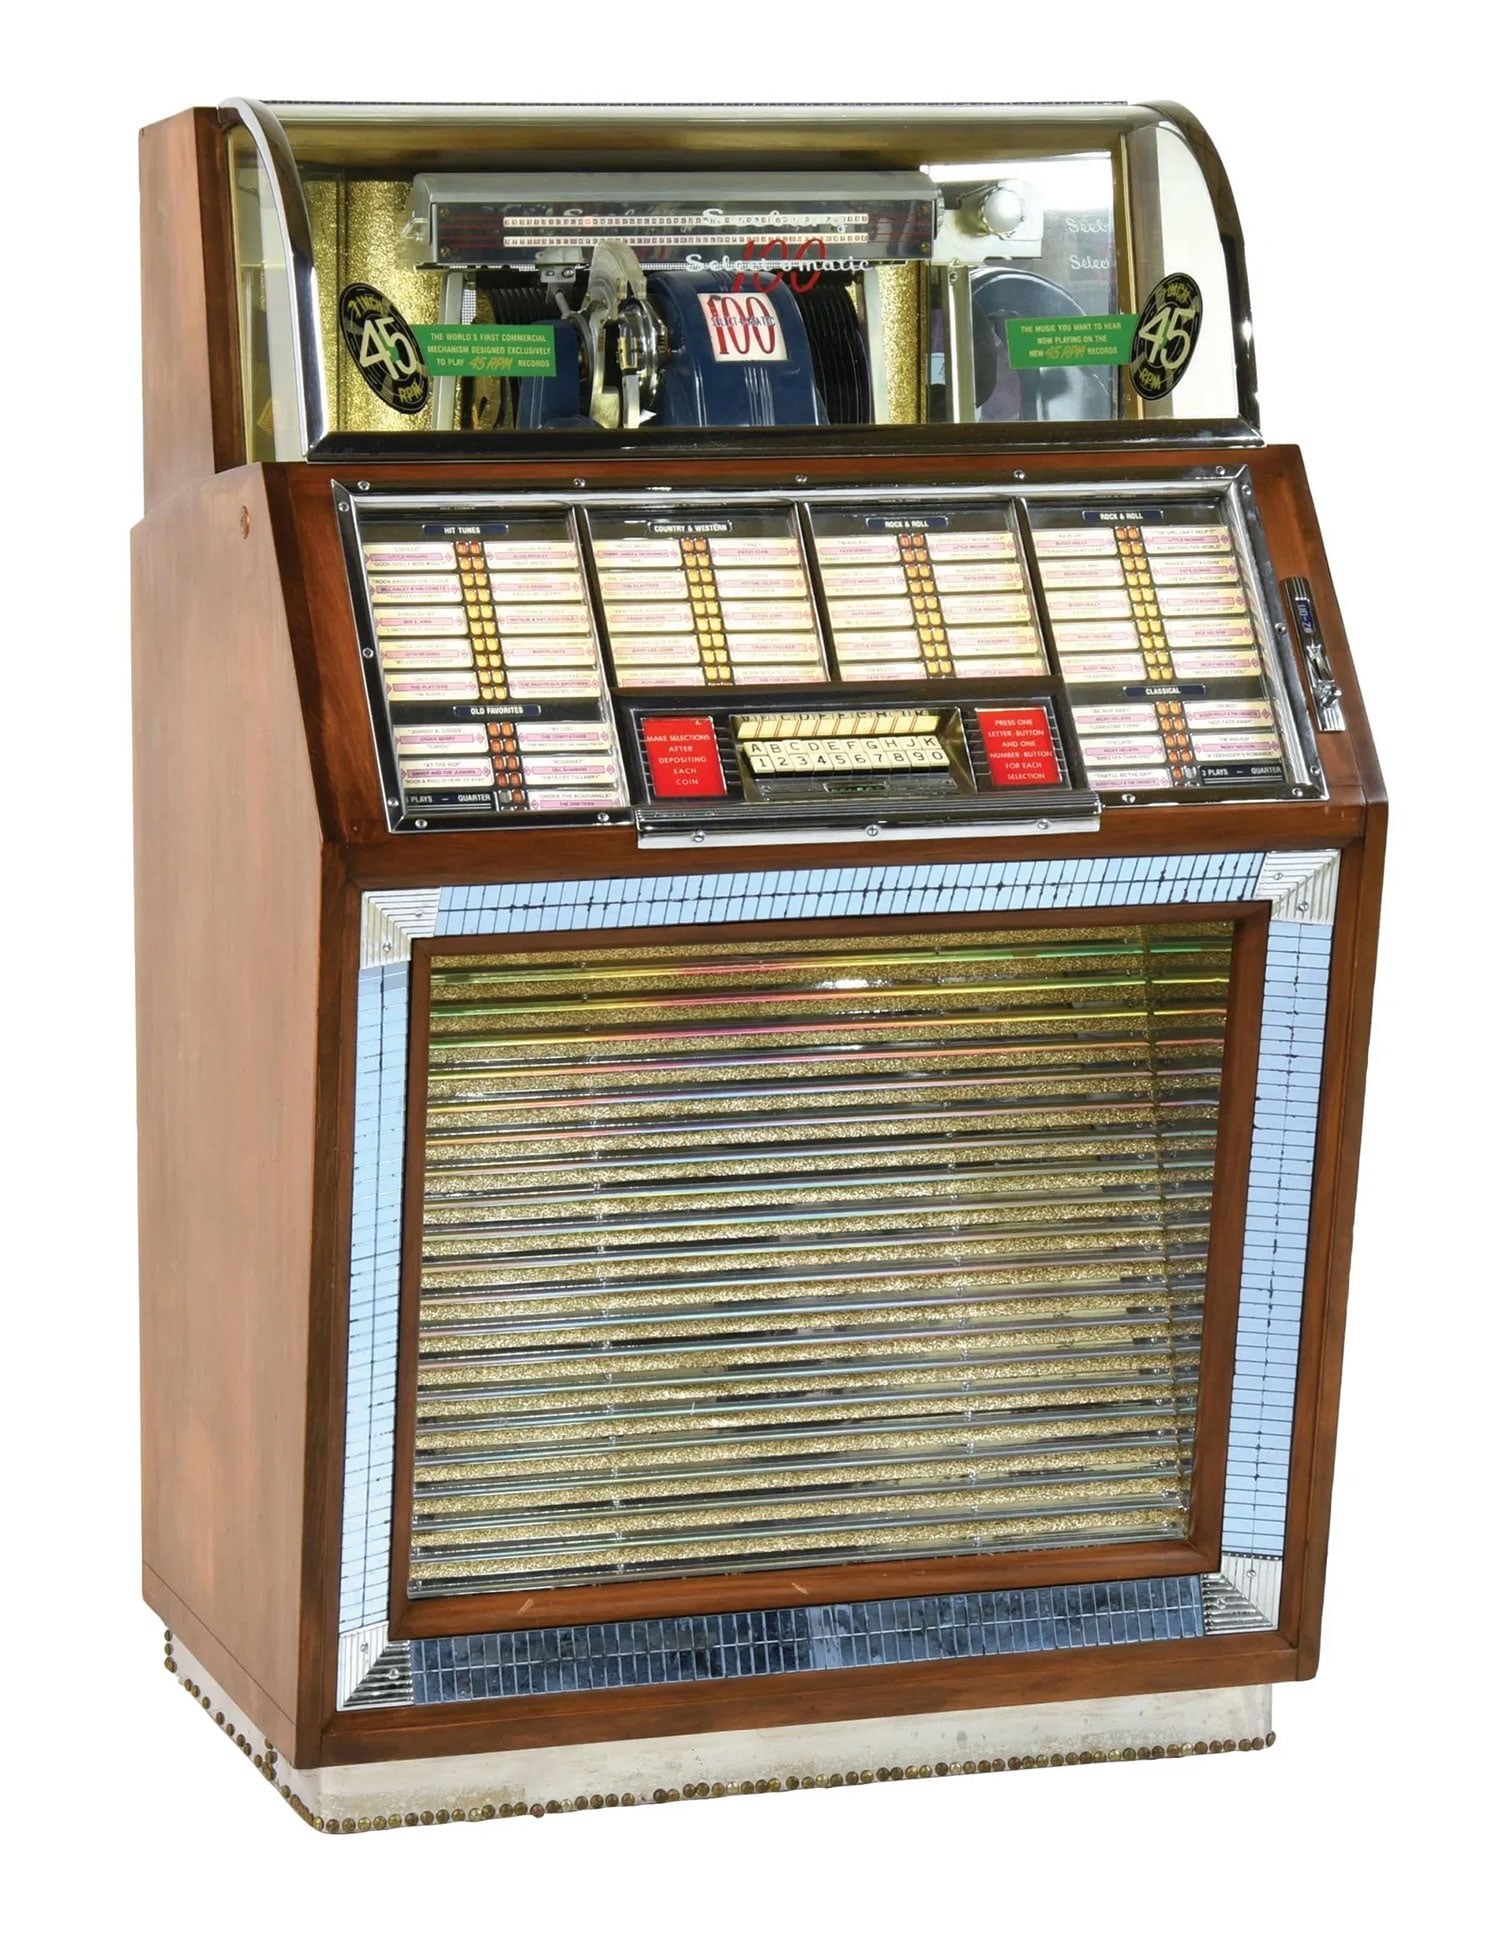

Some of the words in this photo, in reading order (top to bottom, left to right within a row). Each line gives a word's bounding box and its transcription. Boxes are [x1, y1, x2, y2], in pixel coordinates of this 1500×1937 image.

[732, 238, 826, 293] 100
[707, 295, 775, 354] 100
[1139, 306, 1196, 369] 45
[360, 317, 417, 380] 45
[472, 346, 505, 354] DESIGNED
[1088, 347, 1117, 355] RECORDS
[470, 356, 486, 370] 45
[487, 357, 514, 370] RPM
[1139, 368, 1161, 390] RPM
[399, 380, 423, 403] RPM
[654, 524, 685, 533] COUNTRY
[695, 524, 727, 532] WESTERN
[912, 520, 929, 528] ROLL
[1146, 687, 1181, 695] CLASSICAL
[470, 707, 485, 715] OLD
[487, 706, 523, 715] FAVORITES
[752, 744, 761, 752] A
[772, 744, 781, 753] B
[790, 742, 800, 750] C
[809, 742, 819, 750] D
[829, 742, 840, 750] E
[847, 741, 858, 750] F
[867, 741, 878, 749] G
[907, 739, 915, 747] J
[925, 738, 936, 746] K
[760, 759, 767, 767] 1
[780, 757, 789, 765] 2
[799, 757, 808, 765] 3
[818, 756, 826, 764] 4
[835, 756, 845, 764] 5
[855, 755, 865, 763] 6
[876, 755, 883, 763] 7
[895, 753, 904, 761] 8
[914, 752, 924, 761] 9
[933, 752, 943, 760] 0
